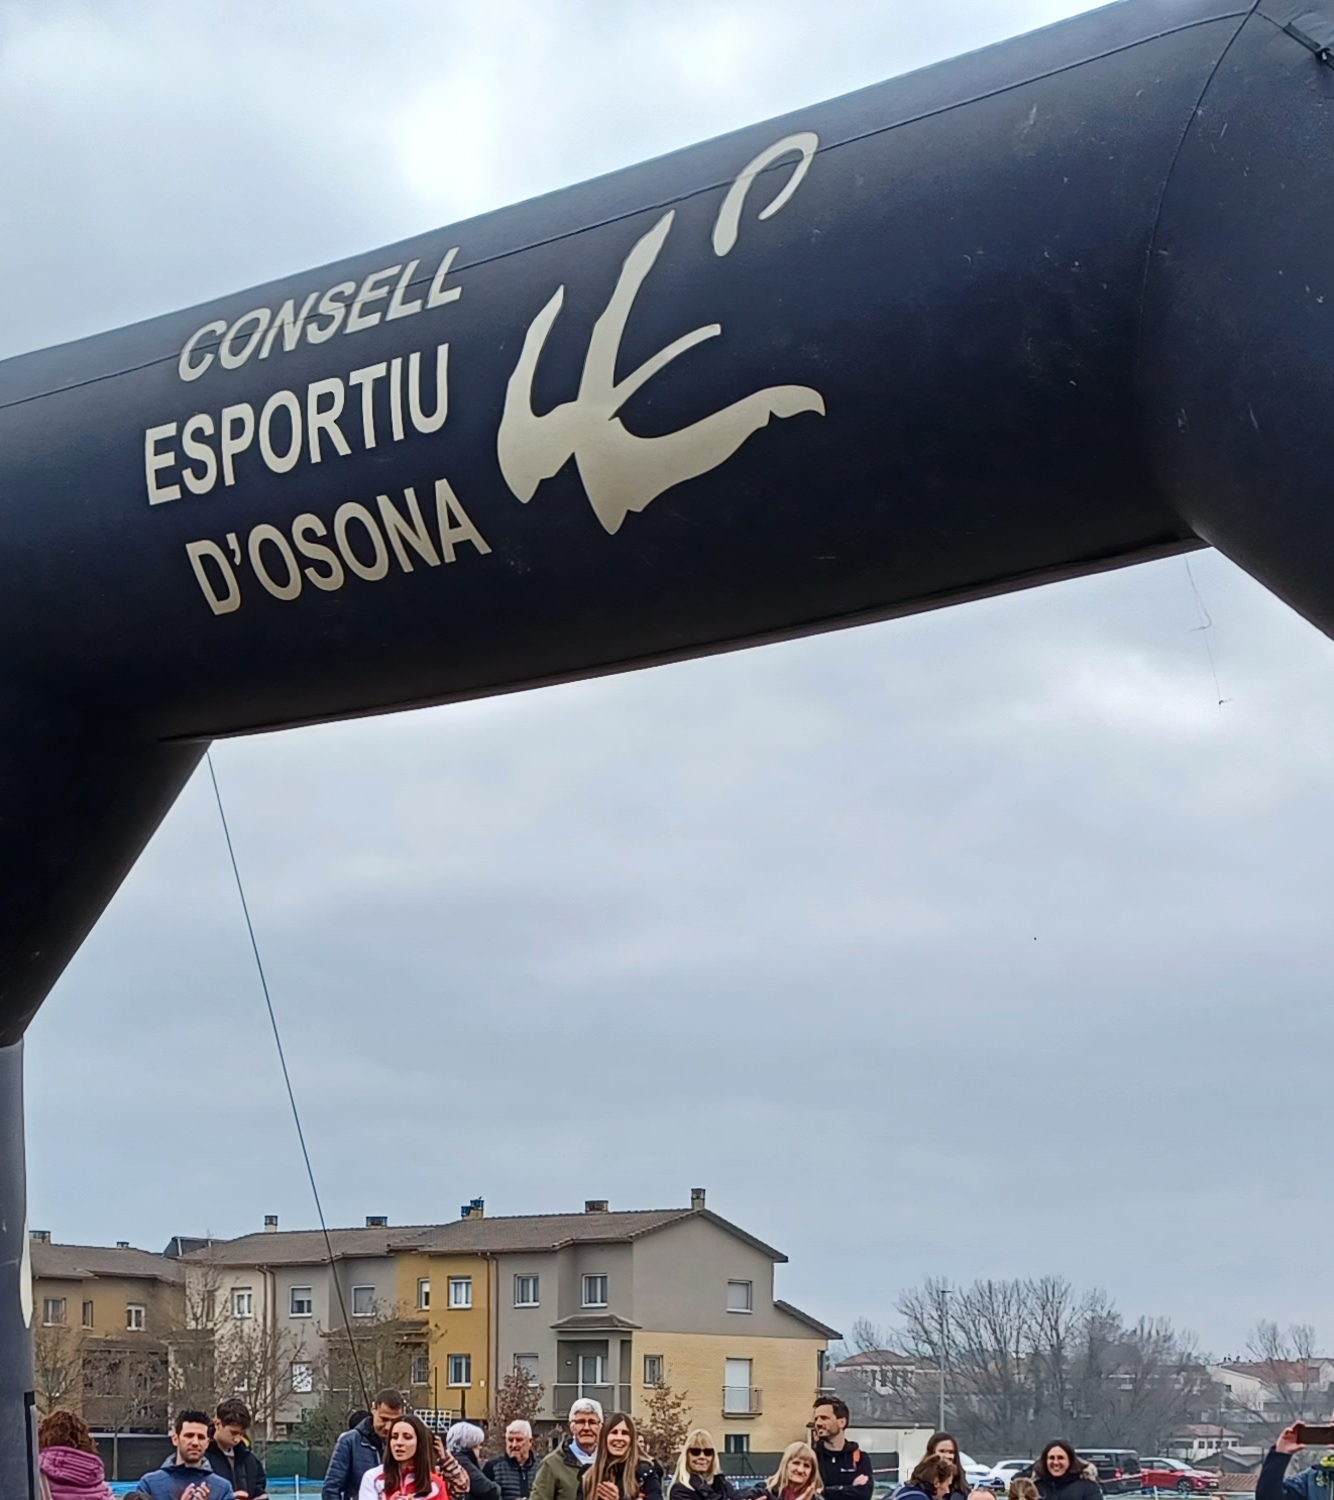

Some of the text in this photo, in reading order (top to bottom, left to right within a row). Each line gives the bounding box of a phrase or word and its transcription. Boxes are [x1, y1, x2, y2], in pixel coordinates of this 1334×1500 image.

[178, 246, 463, 383] CONSELL
[144, 342, 451, 507] ESPORTIU
[185, 478, 492, 617] D'OSONA
